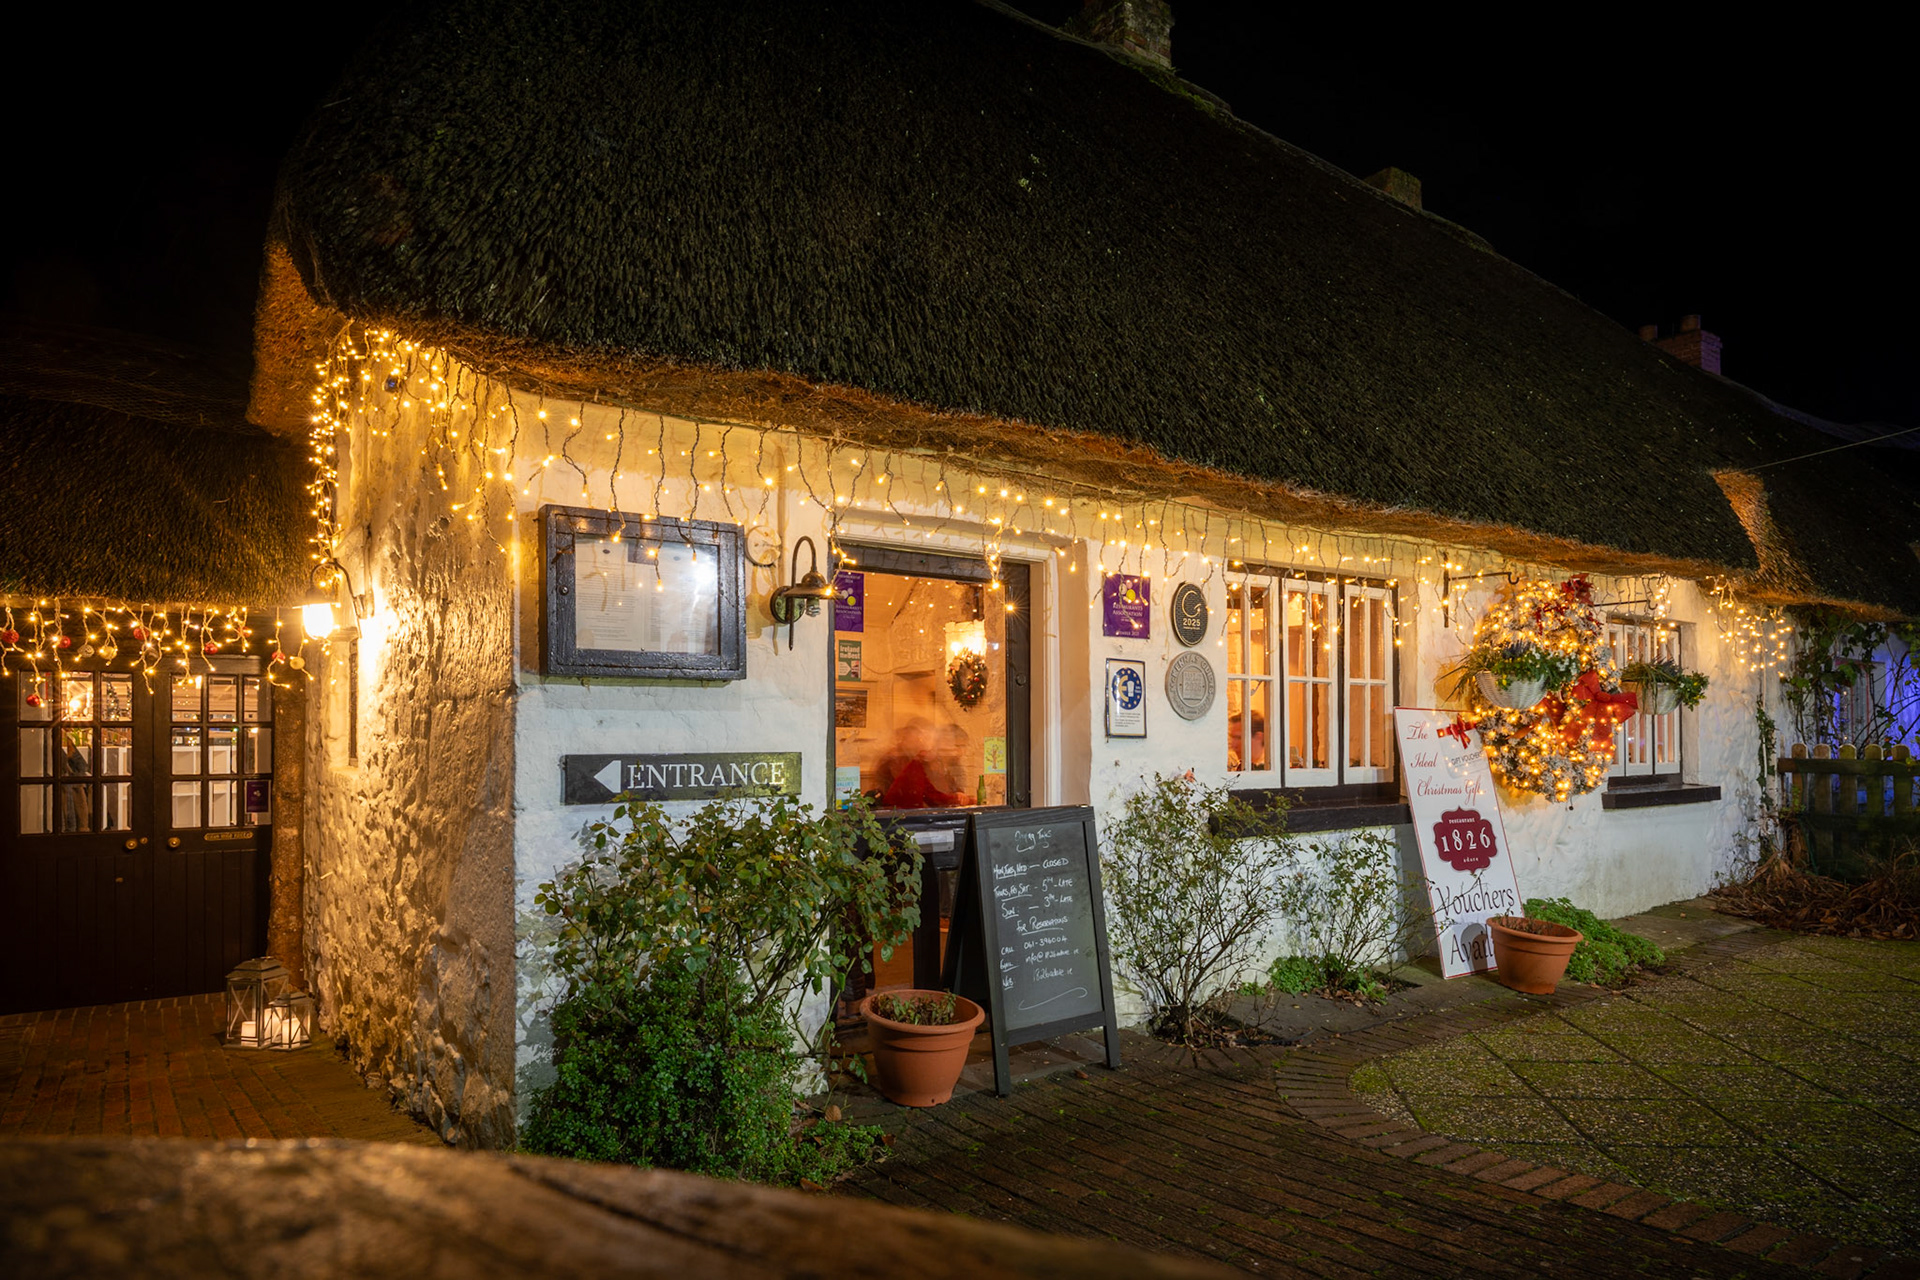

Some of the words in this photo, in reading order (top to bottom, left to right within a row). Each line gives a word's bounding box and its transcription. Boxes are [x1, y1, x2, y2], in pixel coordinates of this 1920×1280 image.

[1182, 618, 1200, 627] 2025
[1406, 721, 1428, 740] The
[1410, 752, 1438, 768] Ideal
[627, 762, 785, 790] ENTRANCE
[1417, 776, 1462, 797] Christmas
[1442, 826, 1490, 852] 1826
[1042, 858, 1069, 869] CLOSED
[1436, 878, 1514, 916] Vouchers
